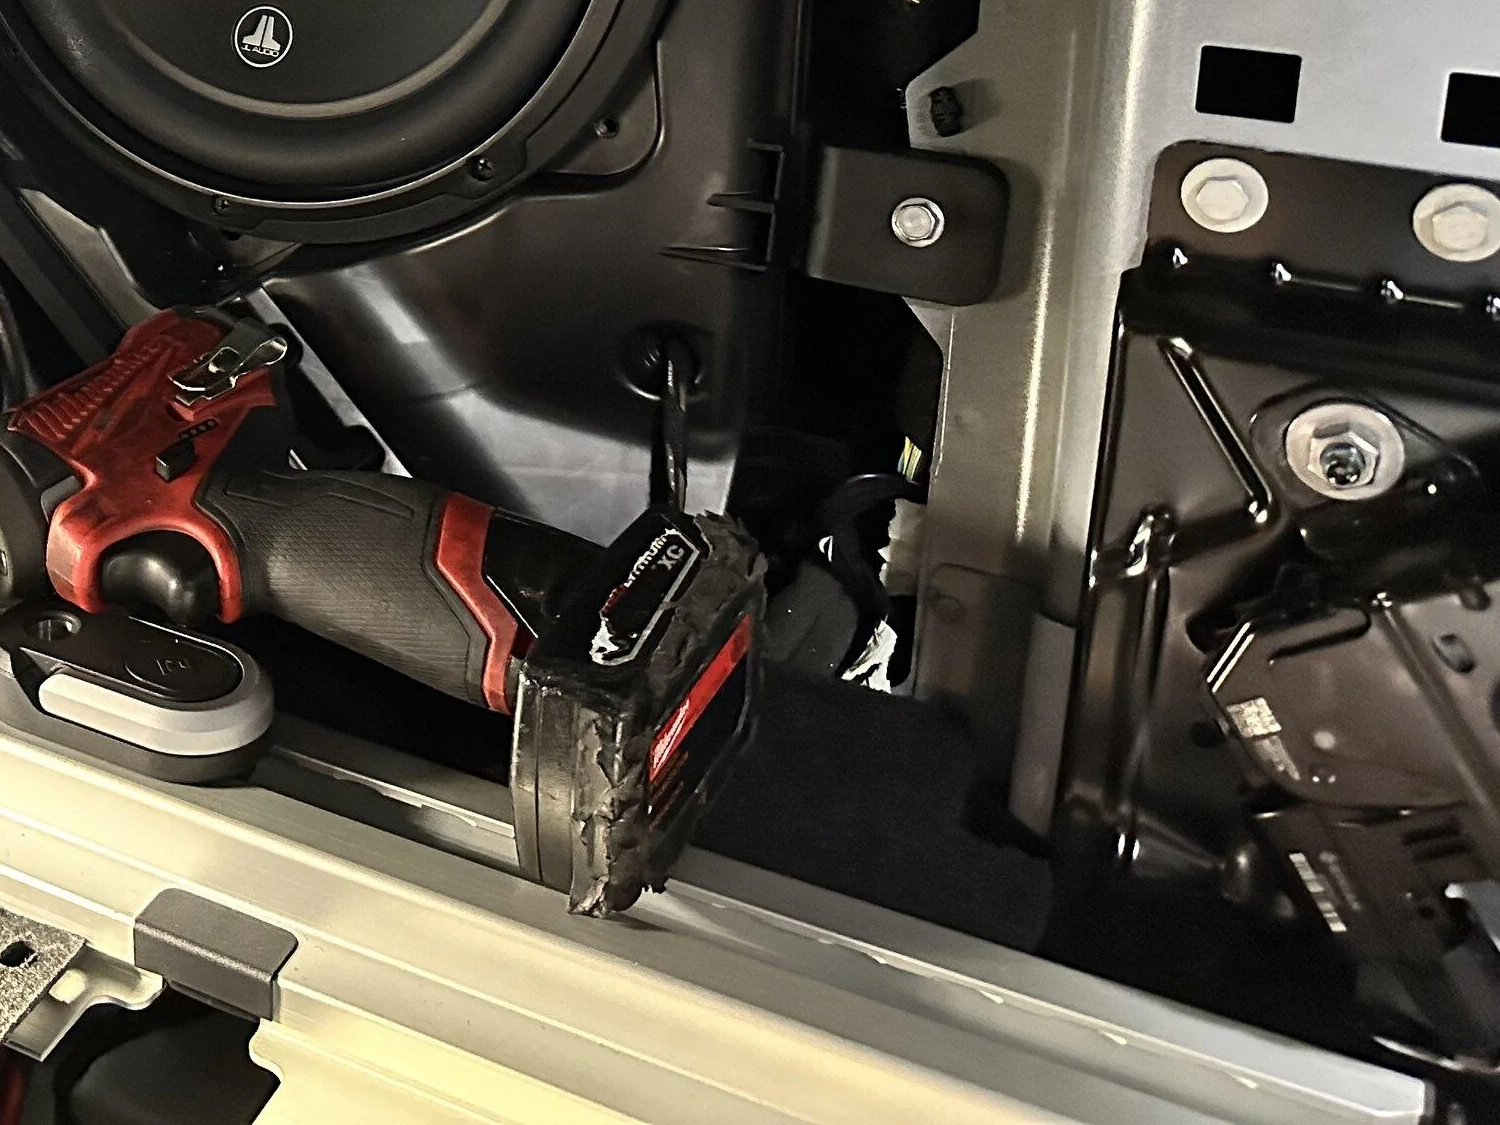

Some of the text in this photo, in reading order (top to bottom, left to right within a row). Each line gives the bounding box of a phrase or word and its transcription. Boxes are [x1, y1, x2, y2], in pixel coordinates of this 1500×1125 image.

[240, 44, 280, 58] JL AUDIO
[656, 544, 685, 571] XC
